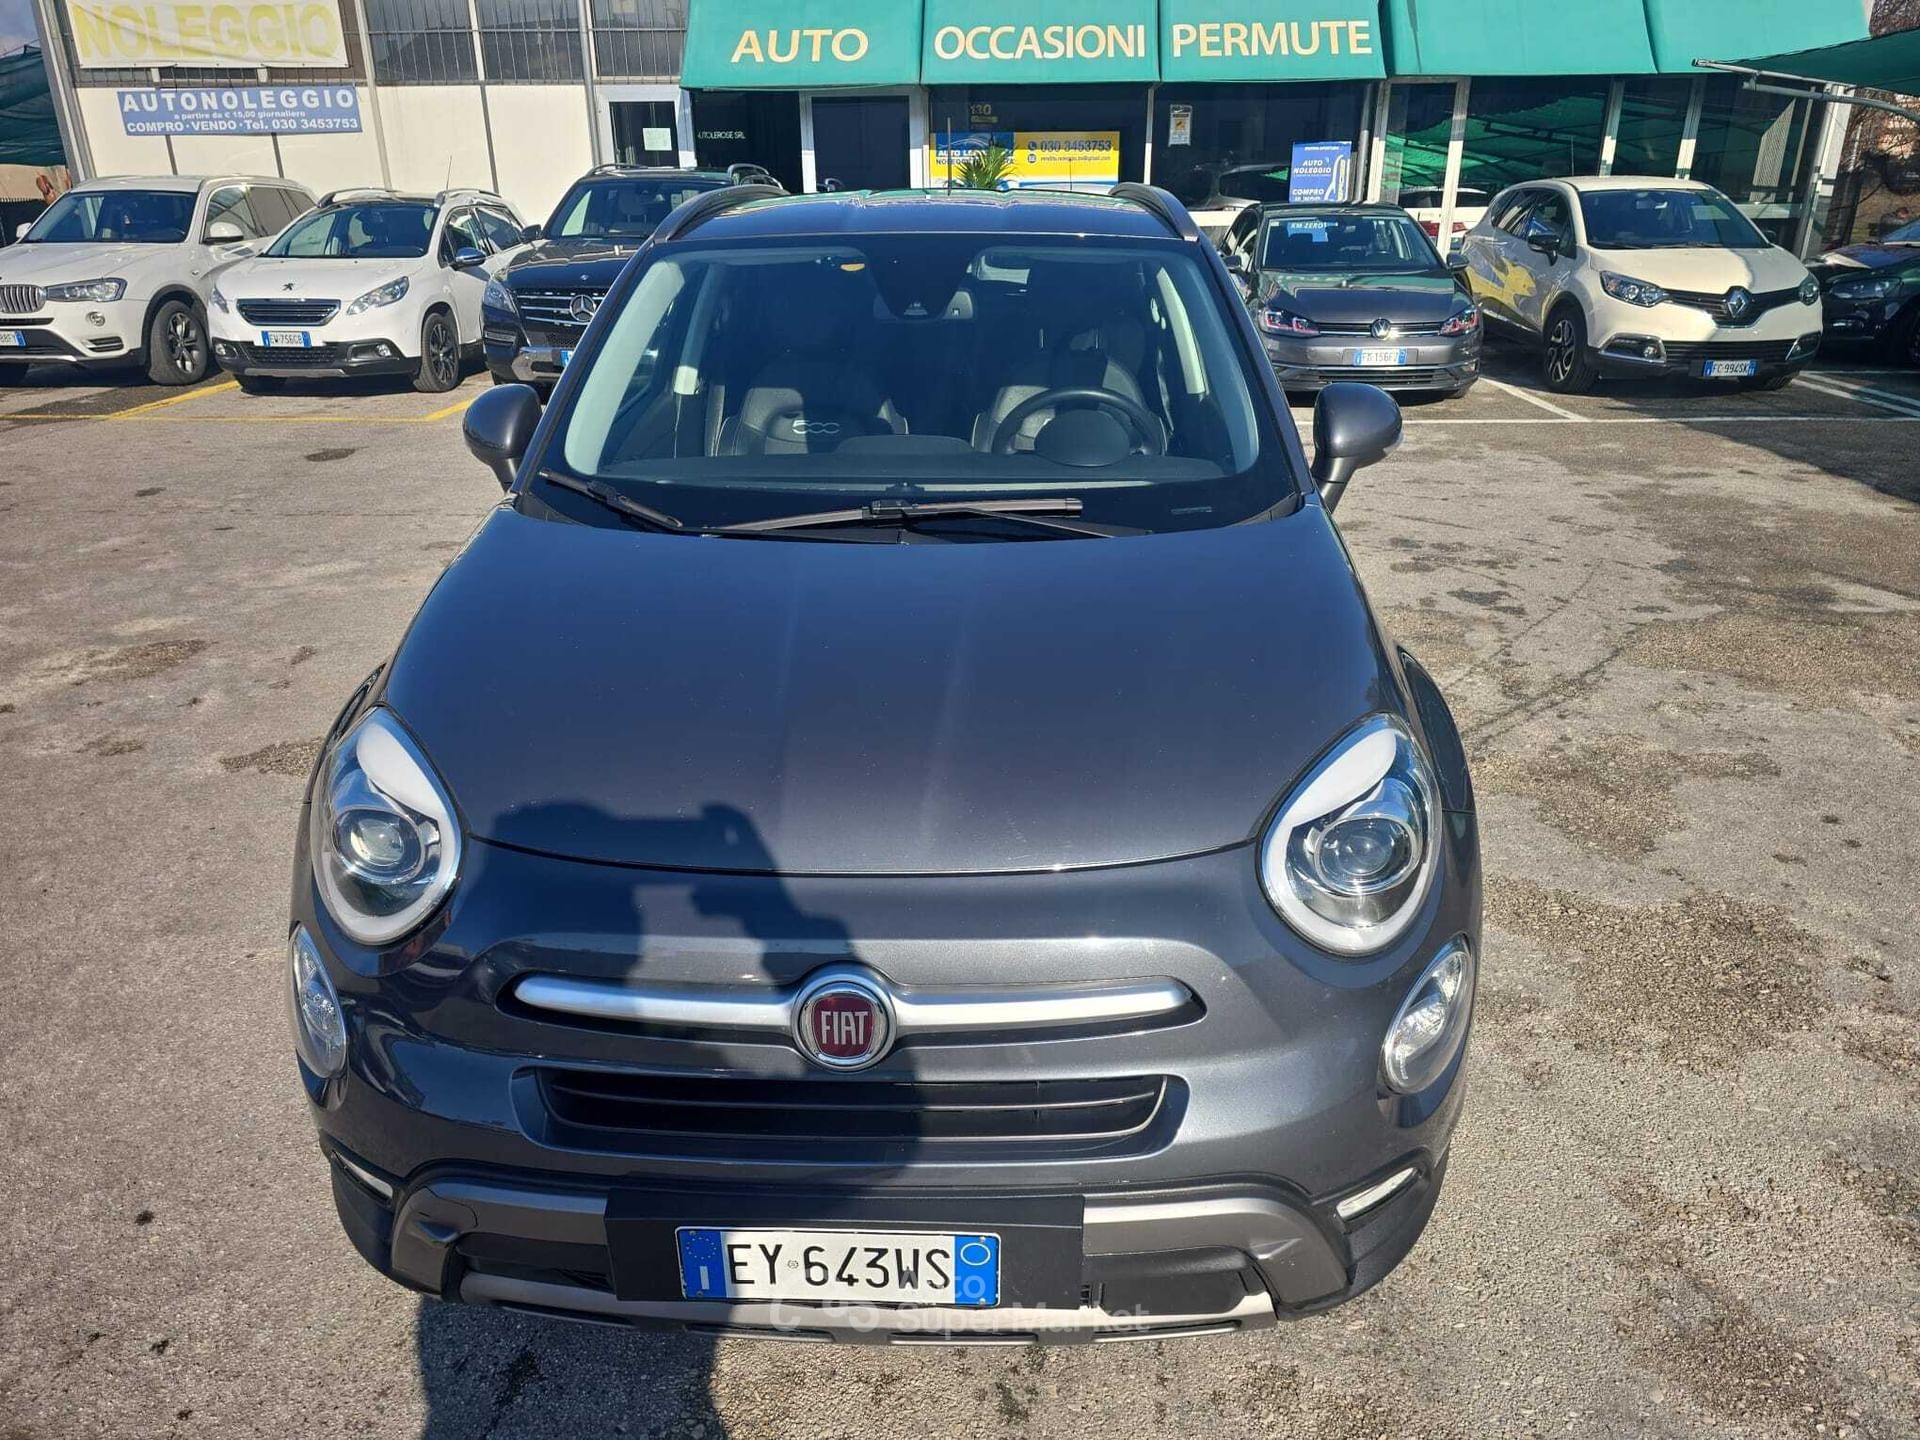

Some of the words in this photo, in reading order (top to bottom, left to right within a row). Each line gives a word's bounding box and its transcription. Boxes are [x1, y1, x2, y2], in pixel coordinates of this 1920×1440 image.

[73, 4, 338, 58] NOLEGGIO
[730, 27, 869, 64] AUTO
[933, 24, 1145, 60] OCCASIONI
[1172, 20, 1372, 58] PERMUTE
[123, 89, 353, 112] AUTONOLEGGIO
[182, 112, 210, 121] partire
[258, 110, 306, 118] giornaliero
[127, 121, 184, 132] COMPRO
[191, 120, 237, 131] VENDO
[244, 119, 268, 130] Tel.
[271, 119, 297, 129] 030
[300, 118, 358, 129] 3453753
[821, 1010, 868, 1045] FIAT
[726, 1243, 783, 1285] EY
[803, 1245, 951, 1290] 643WS
